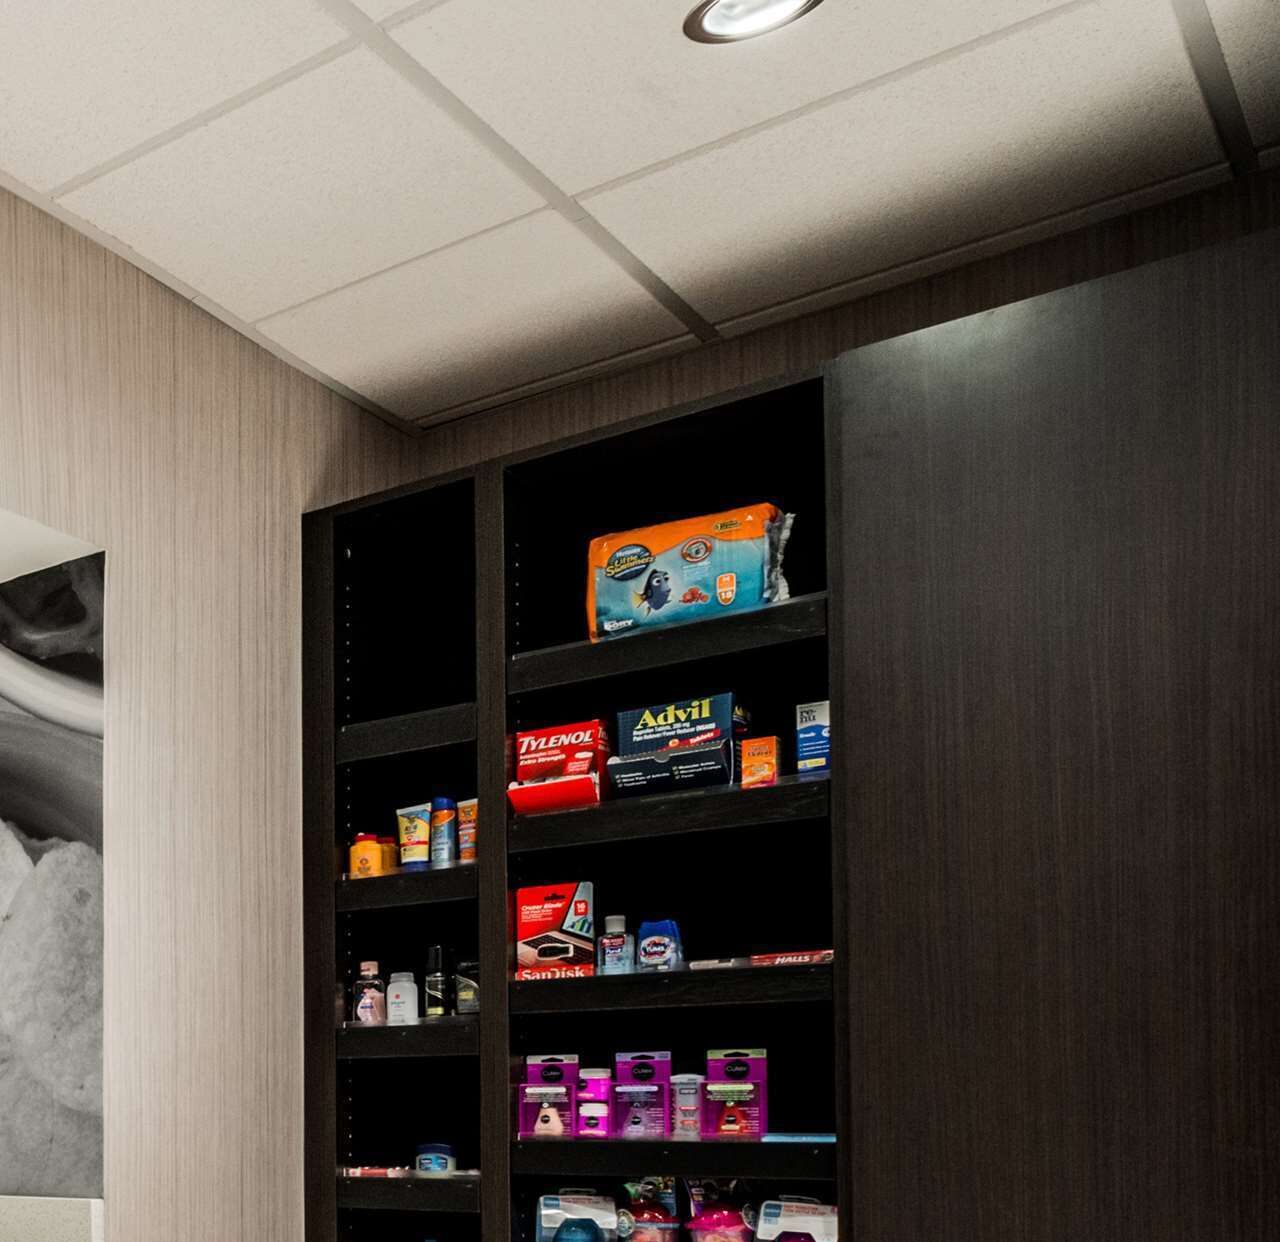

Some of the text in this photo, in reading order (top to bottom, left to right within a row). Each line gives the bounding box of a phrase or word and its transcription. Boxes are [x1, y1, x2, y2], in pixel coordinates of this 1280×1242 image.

[634, 698, 711, 730] Advil
[519, 730, 593, 754] TYLENOL
[774, 955, 810, 964] HALLS
[521, 967, 585, 980] SanDisk
